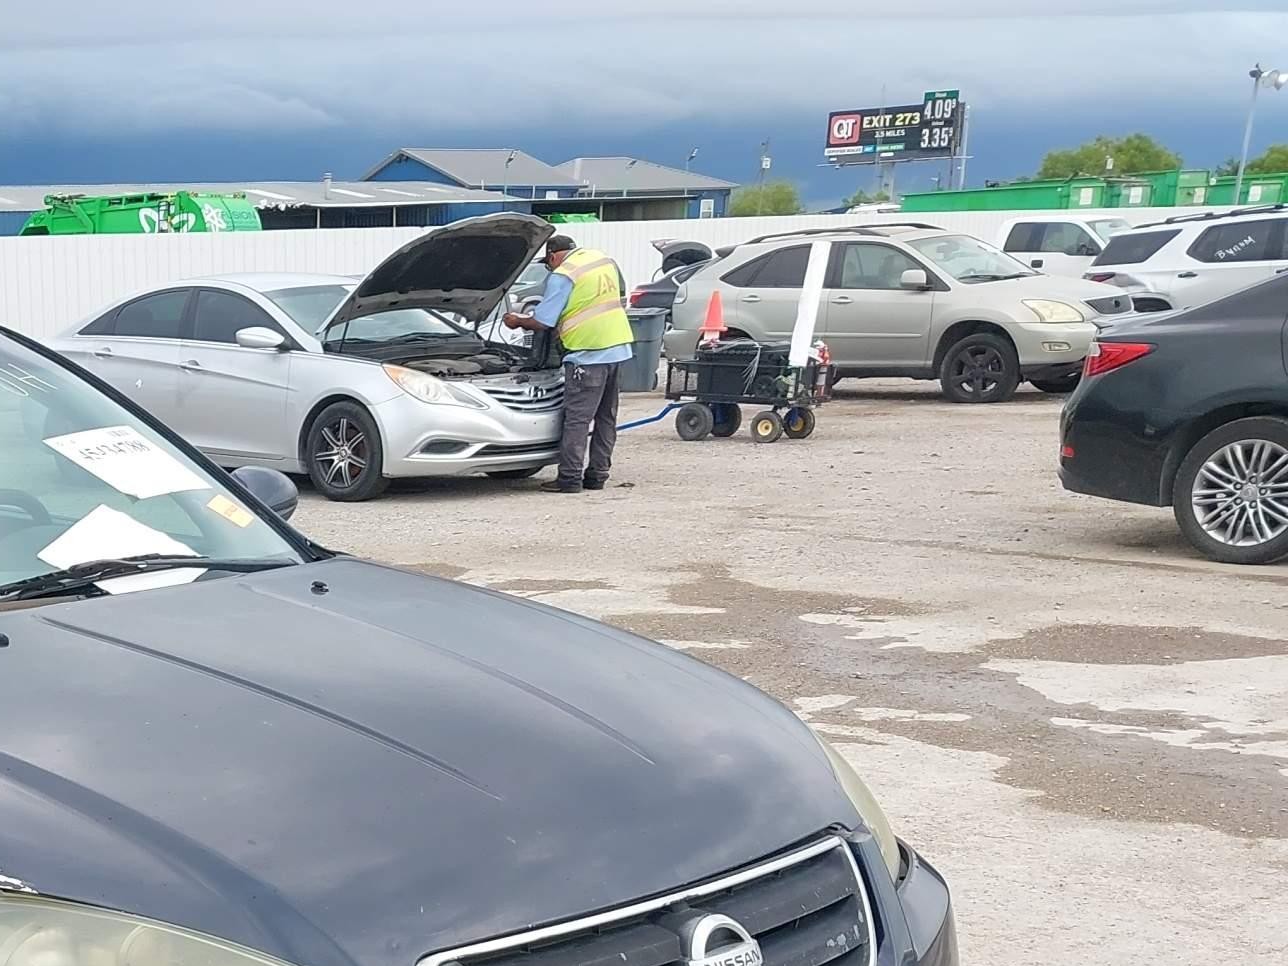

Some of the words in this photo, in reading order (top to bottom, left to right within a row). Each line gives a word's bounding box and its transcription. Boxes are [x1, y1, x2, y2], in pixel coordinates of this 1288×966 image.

[862, 114, 893, 129] EXIT
[894, 112, 921, 126] 273
[833, 119, 856, 140] QT
[885, 128, 906, 137] MILES
